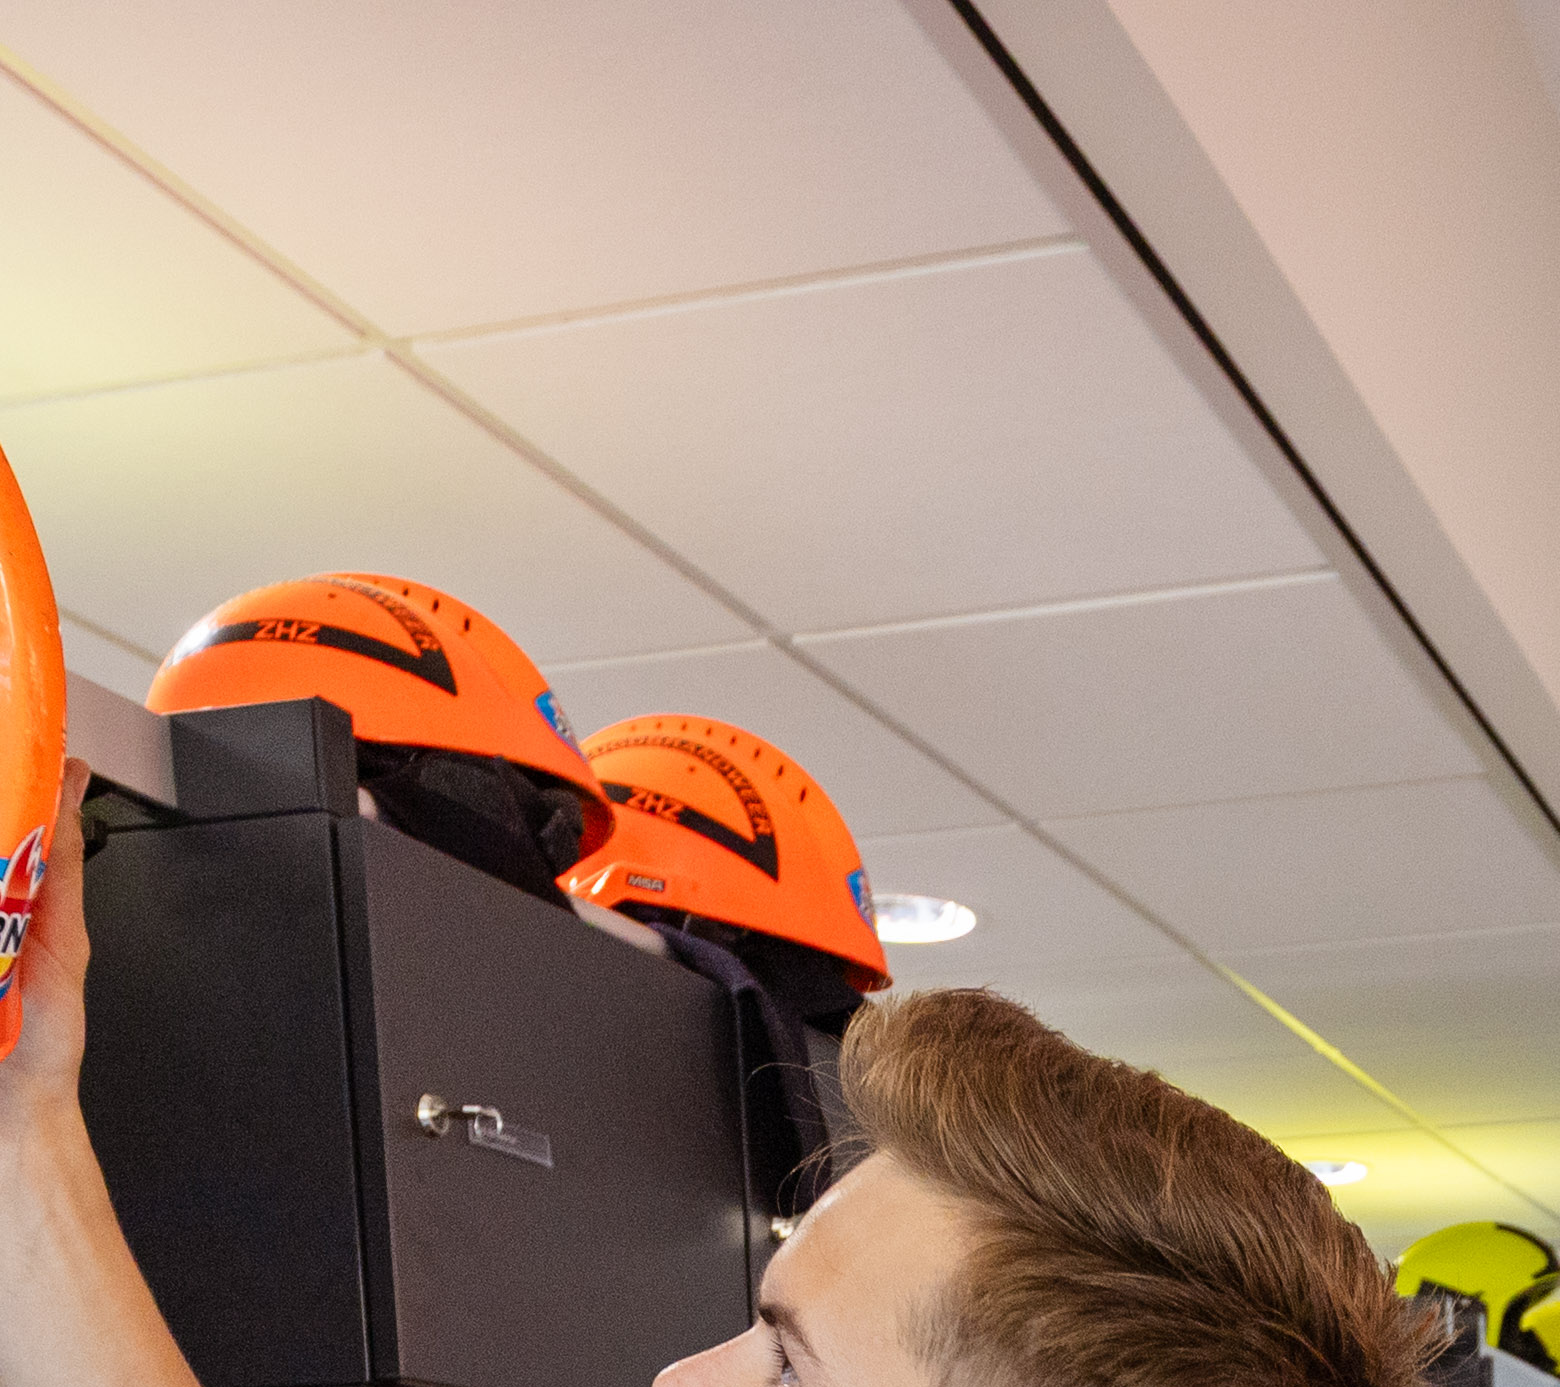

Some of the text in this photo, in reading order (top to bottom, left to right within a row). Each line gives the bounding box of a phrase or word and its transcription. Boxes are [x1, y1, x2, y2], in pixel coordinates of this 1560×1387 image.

[255, 619, 320, 644] ZHZ
[625, 789, 682, 823] ZHZ
[628, 874, 665, 892] MSA
